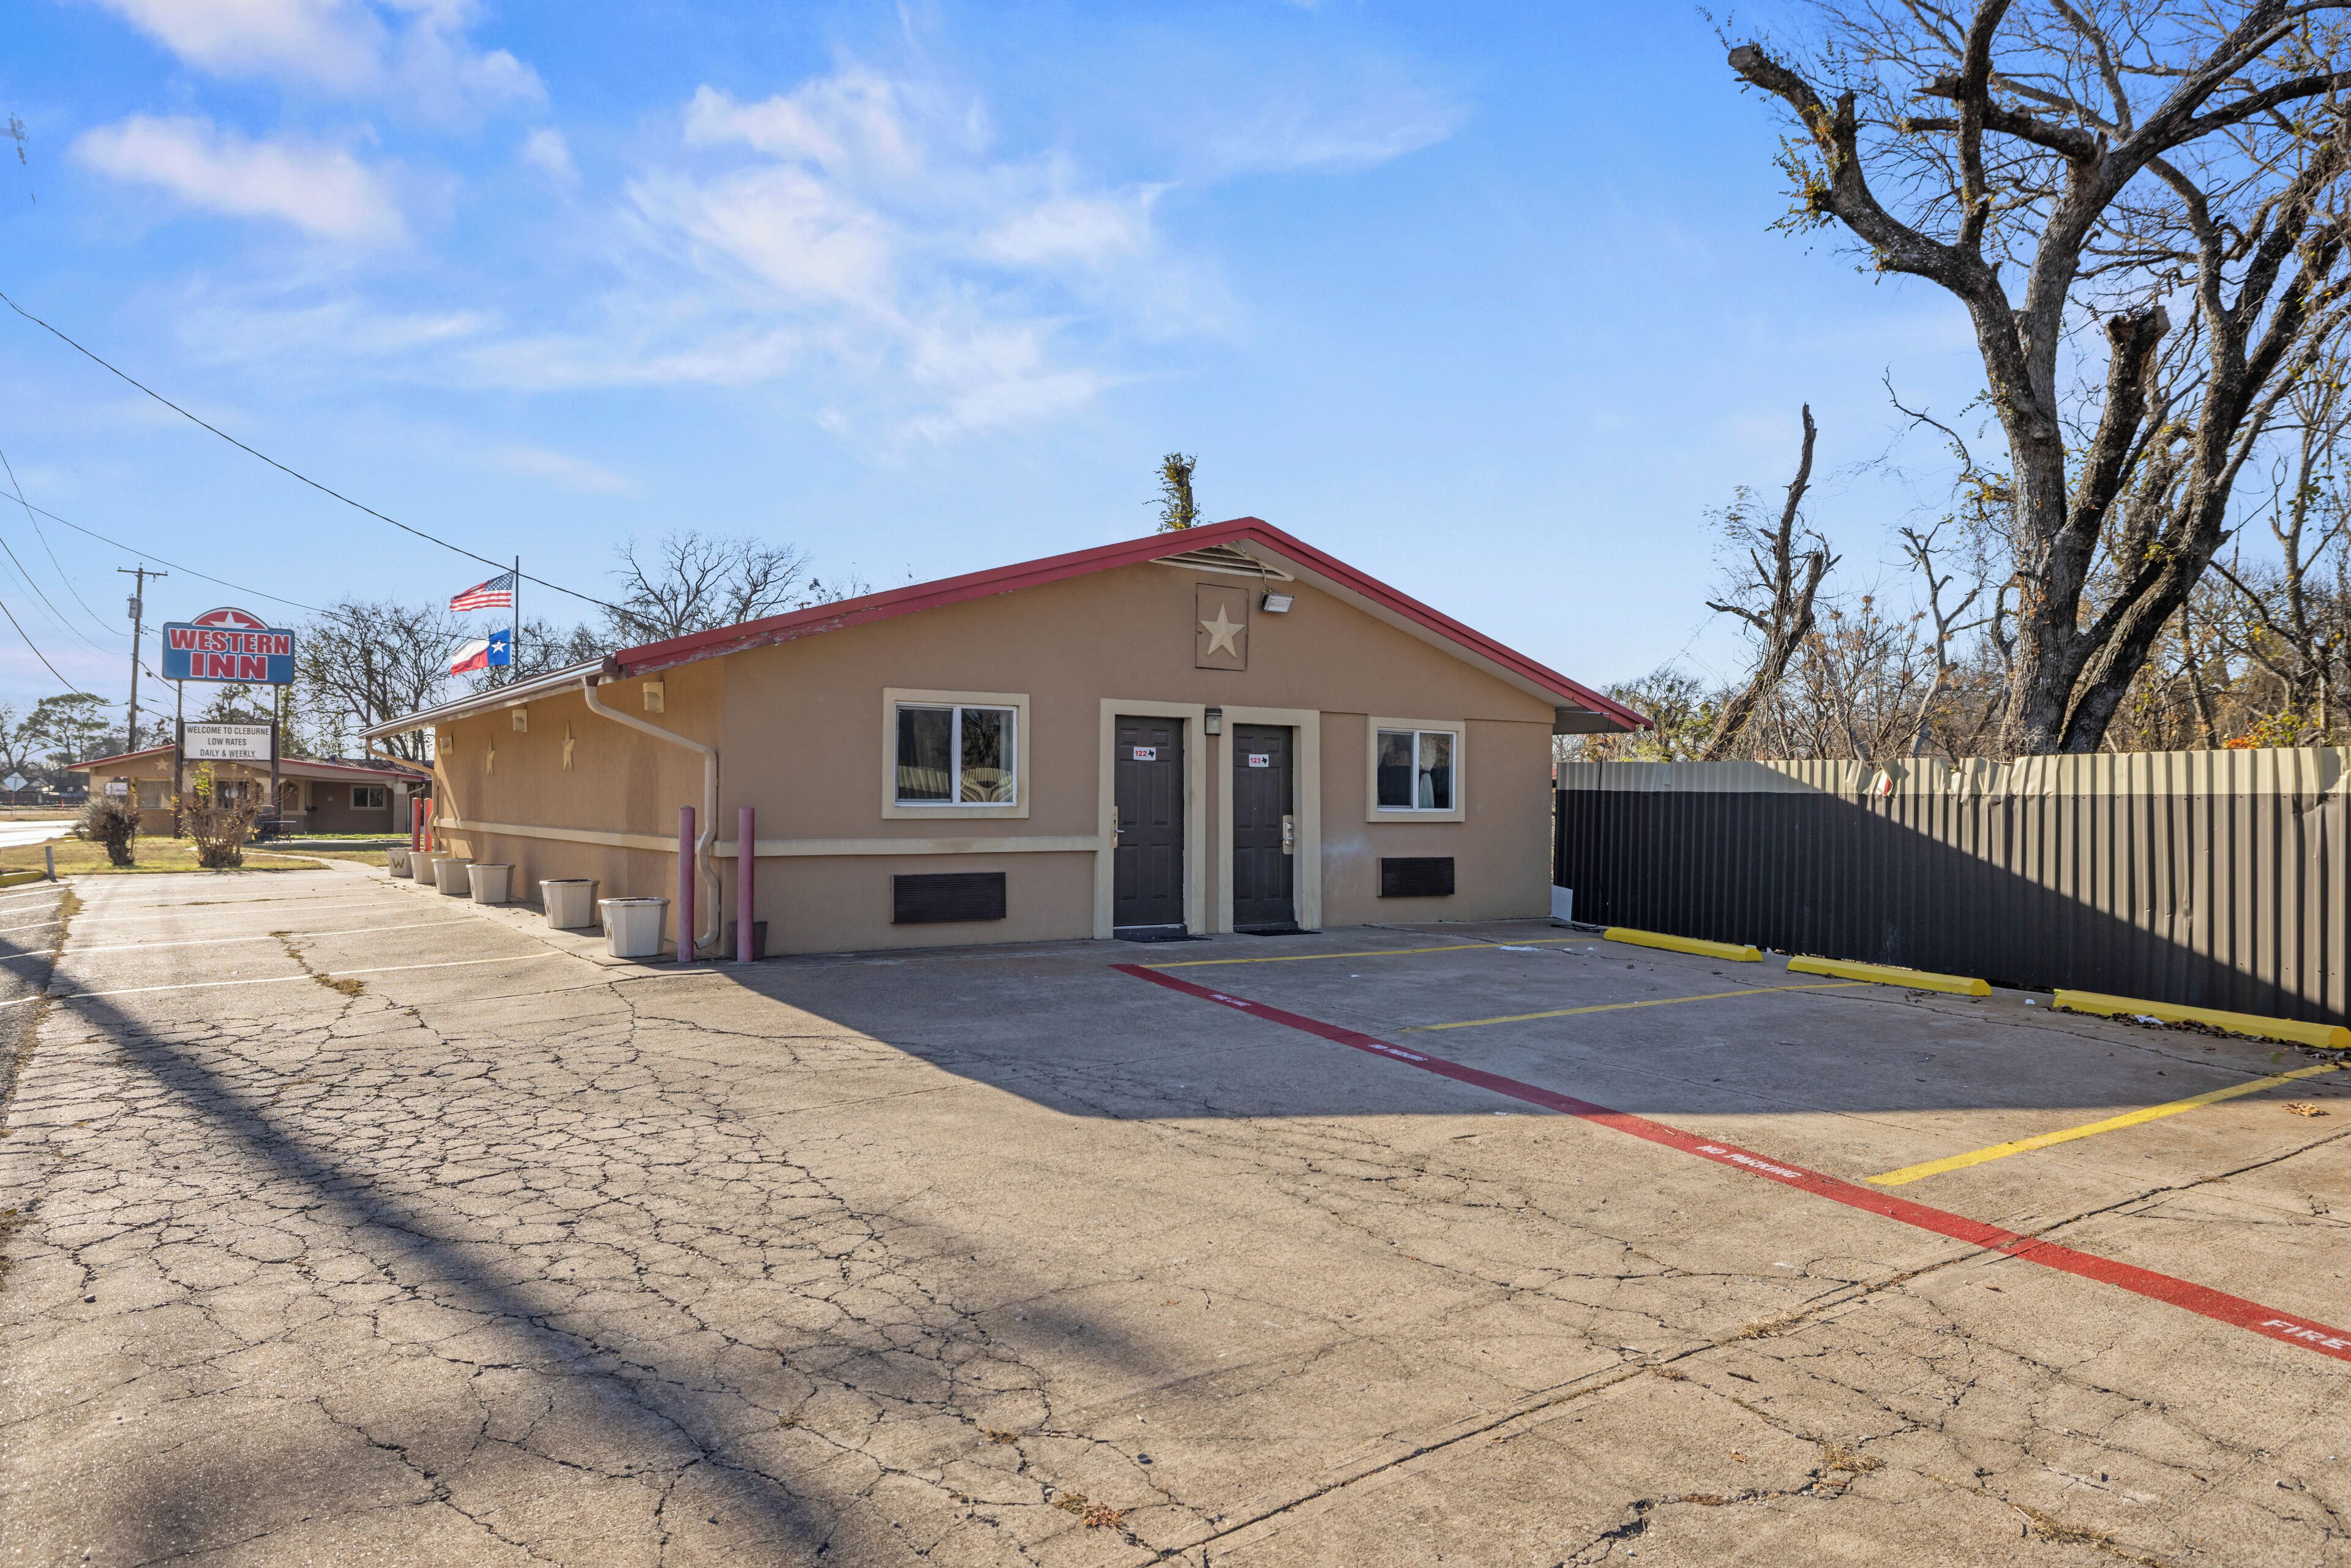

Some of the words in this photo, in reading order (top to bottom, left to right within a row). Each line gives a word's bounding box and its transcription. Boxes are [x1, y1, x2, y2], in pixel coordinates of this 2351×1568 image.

[168, 628, 291, 655] WESTERN
[190, 651, 268, 680] INN
[392, 858, 405, 869] W
[604, 920, 612, 941] W
[1696, 1146, 1727, 1154] NO
[1723, 1153, 1803, 1178] PARKING
[2261, 1319, 2351, 1349] FIRE
